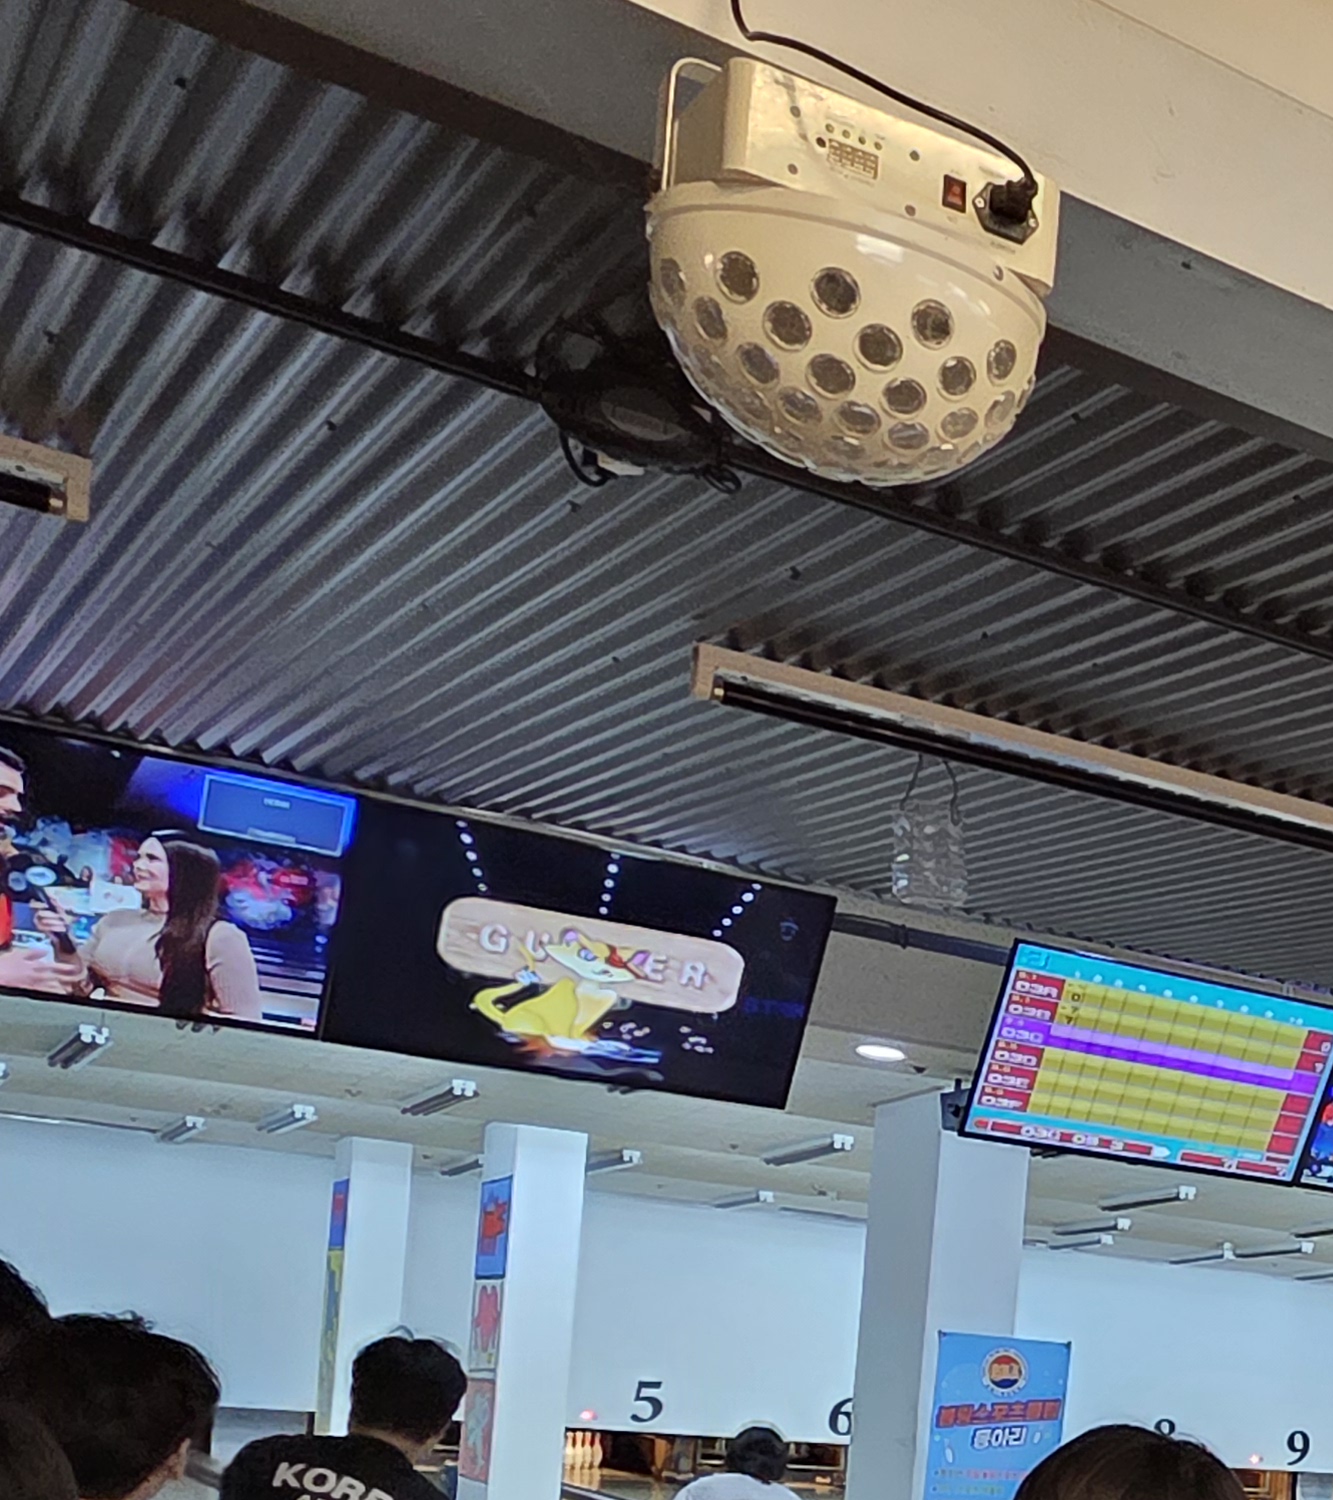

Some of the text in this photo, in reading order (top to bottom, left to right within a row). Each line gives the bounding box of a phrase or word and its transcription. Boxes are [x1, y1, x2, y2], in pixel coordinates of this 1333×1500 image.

[479, 923, 706, 988] GUER
[630, 1380, 663, 1422] 5
[828, 1397, 853, 1436] 6
[1286, 1430, 1311, 1466] 9
